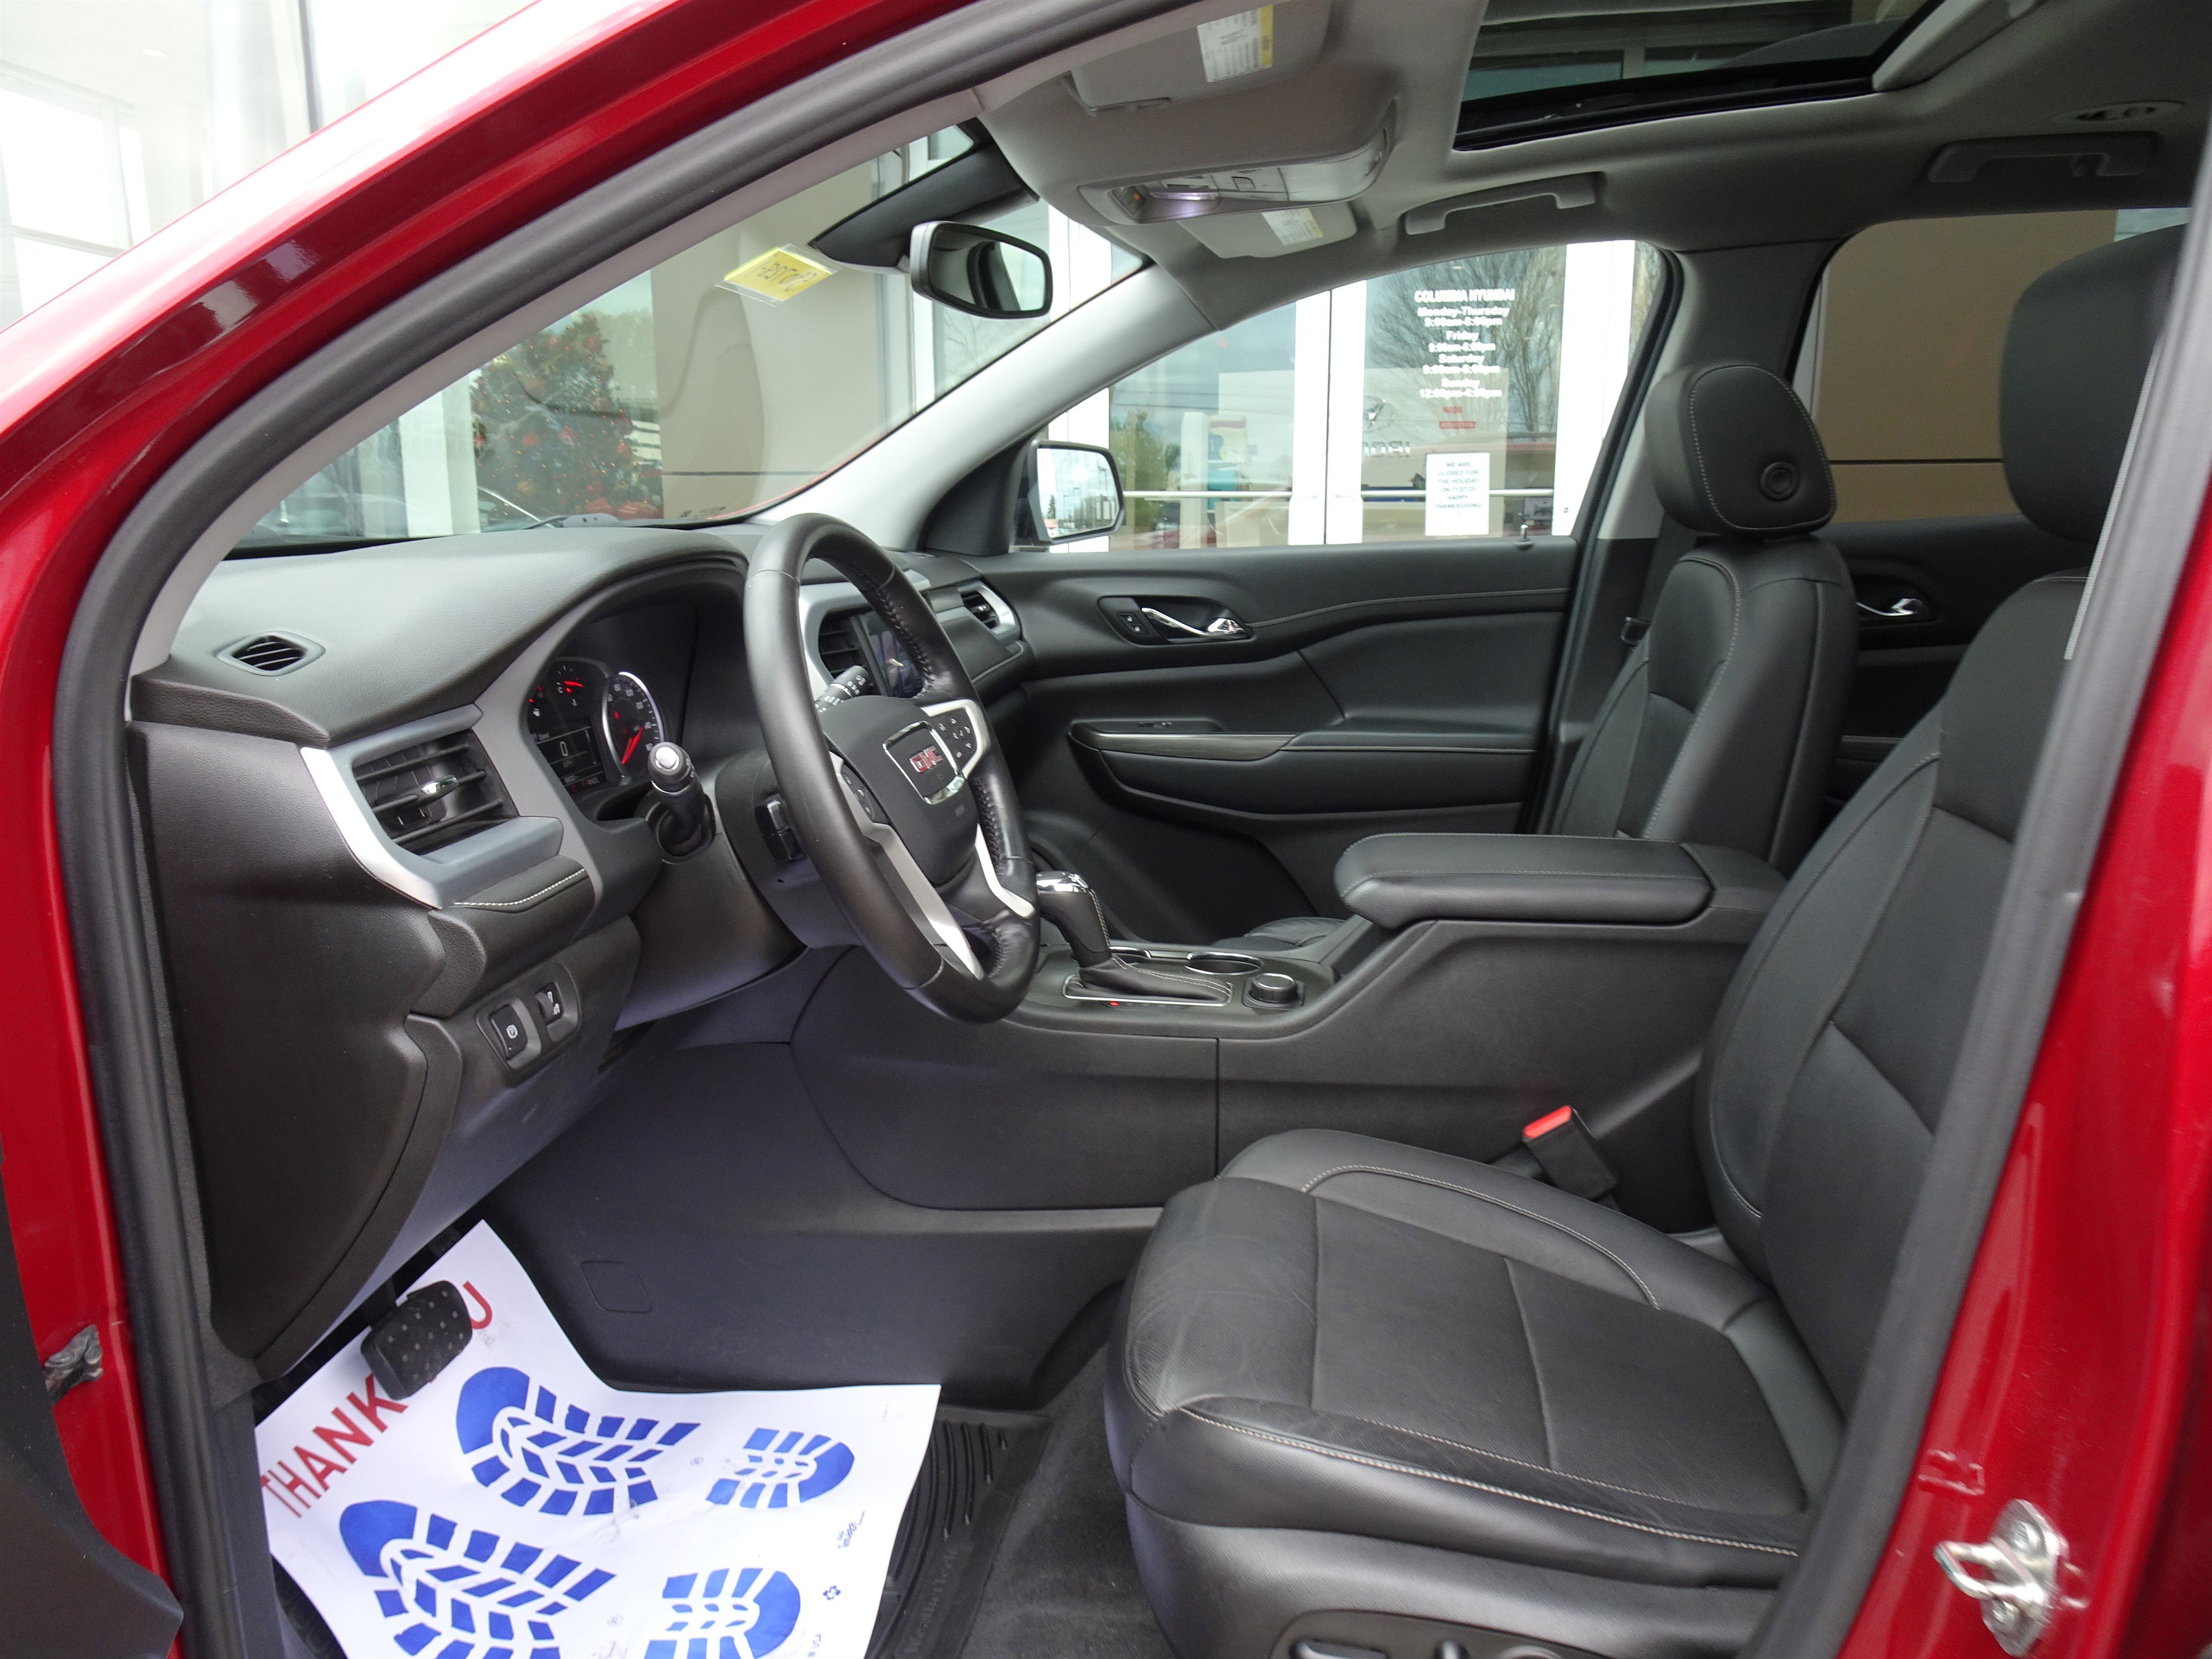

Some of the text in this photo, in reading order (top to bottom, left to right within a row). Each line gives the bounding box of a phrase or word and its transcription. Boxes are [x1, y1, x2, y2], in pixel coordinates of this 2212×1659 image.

[1469, 288, 1515, 301] HYUNDAI
[1417, 306, 1510, 318] Monday-Thursday
[1446, 331, 1479, 342] Friday
[1439, 353, 1485, 365] Saturday
[1441, 378, 1480, 389] Sunday
[909, 745, 944, 773] GMC
[260, 1373, 409, 1518] THANK
